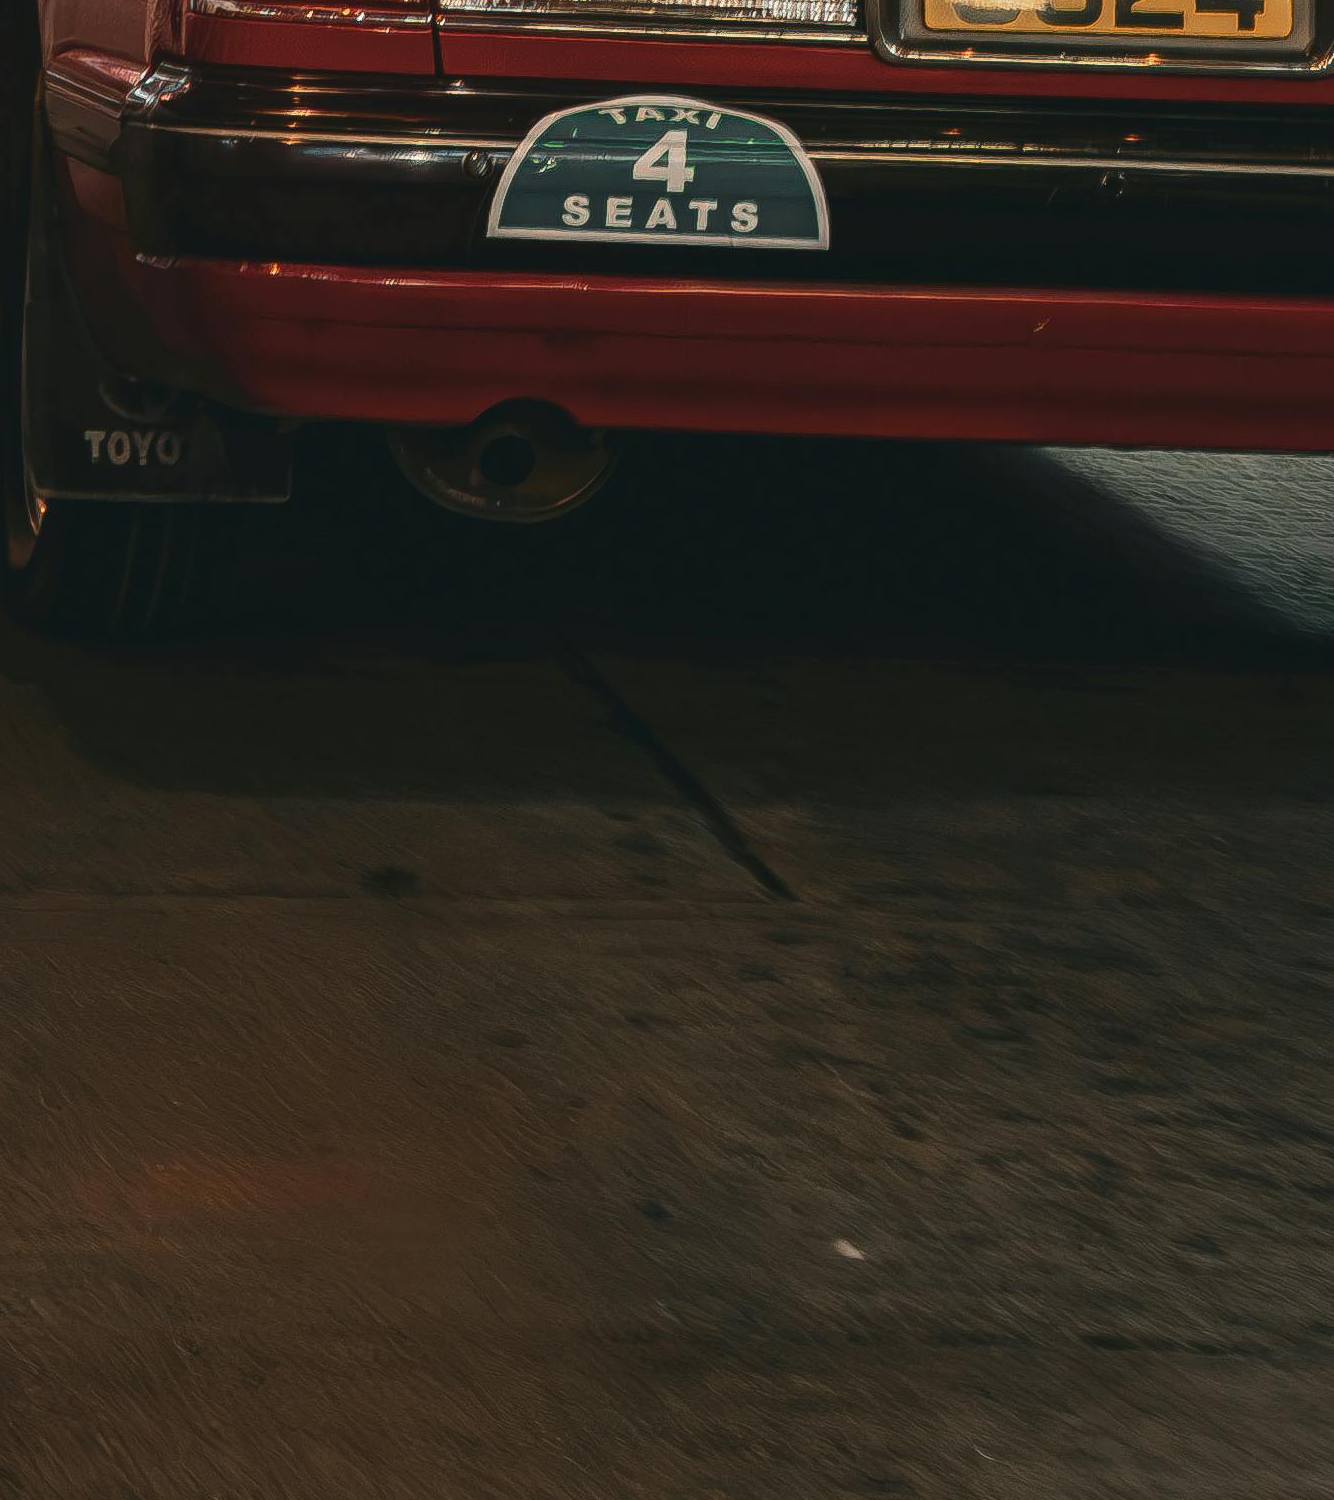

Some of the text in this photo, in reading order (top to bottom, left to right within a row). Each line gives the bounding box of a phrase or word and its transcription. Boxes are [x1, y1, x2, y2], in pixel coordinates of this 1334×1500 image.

[598, 105, 724, 132] TAXI
[632, 129, 696, 194] 4
[561, 194, 760, 234] SEATS
